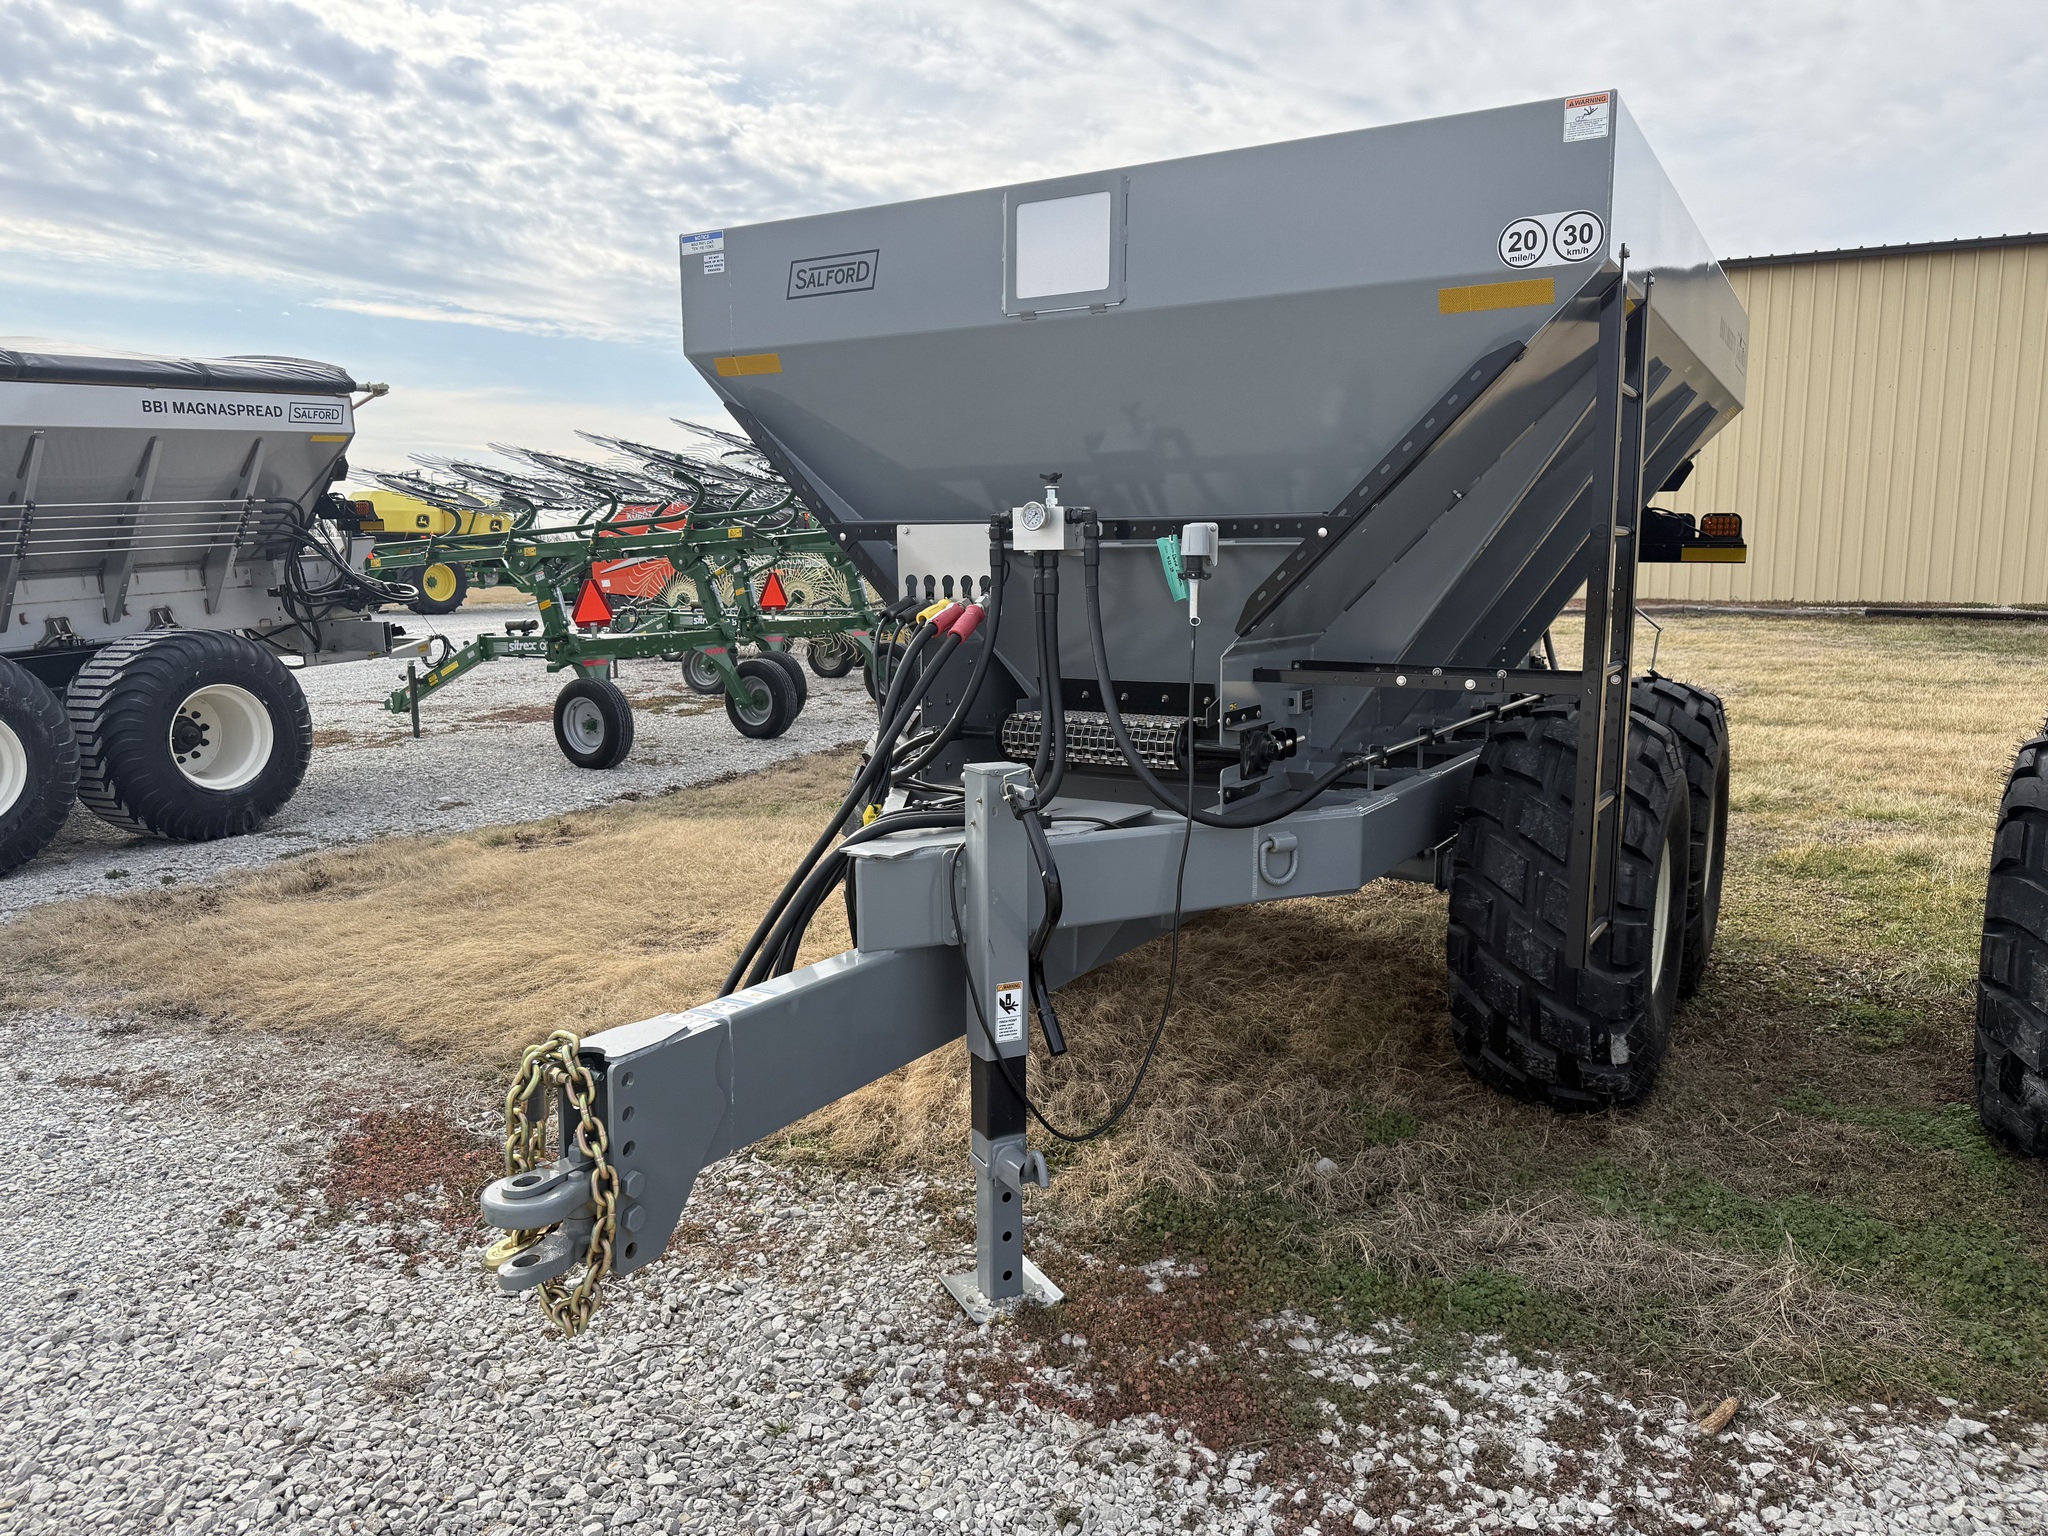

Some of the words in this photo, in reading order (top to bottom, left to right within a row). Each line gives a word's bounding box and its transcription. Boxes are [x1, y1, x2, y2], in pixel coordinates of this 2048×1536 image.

[1574, 95, 1607, 106] WARNING
[1508, 229, 1538, 253] 20
[1563, 222, 1594, 246] 30
[1509, 252, 1536, 263] mile/h
[1566, 246, 1589, 256] km/h
[795, 260, 870, 290] SALFORD
[142, 400, 168, 414] BBI
[172, 401, 283, 418] MAGNASPREAD
[293, 407, 340, 421] SALFORD
[508, 640, 537, 652] sitrex
